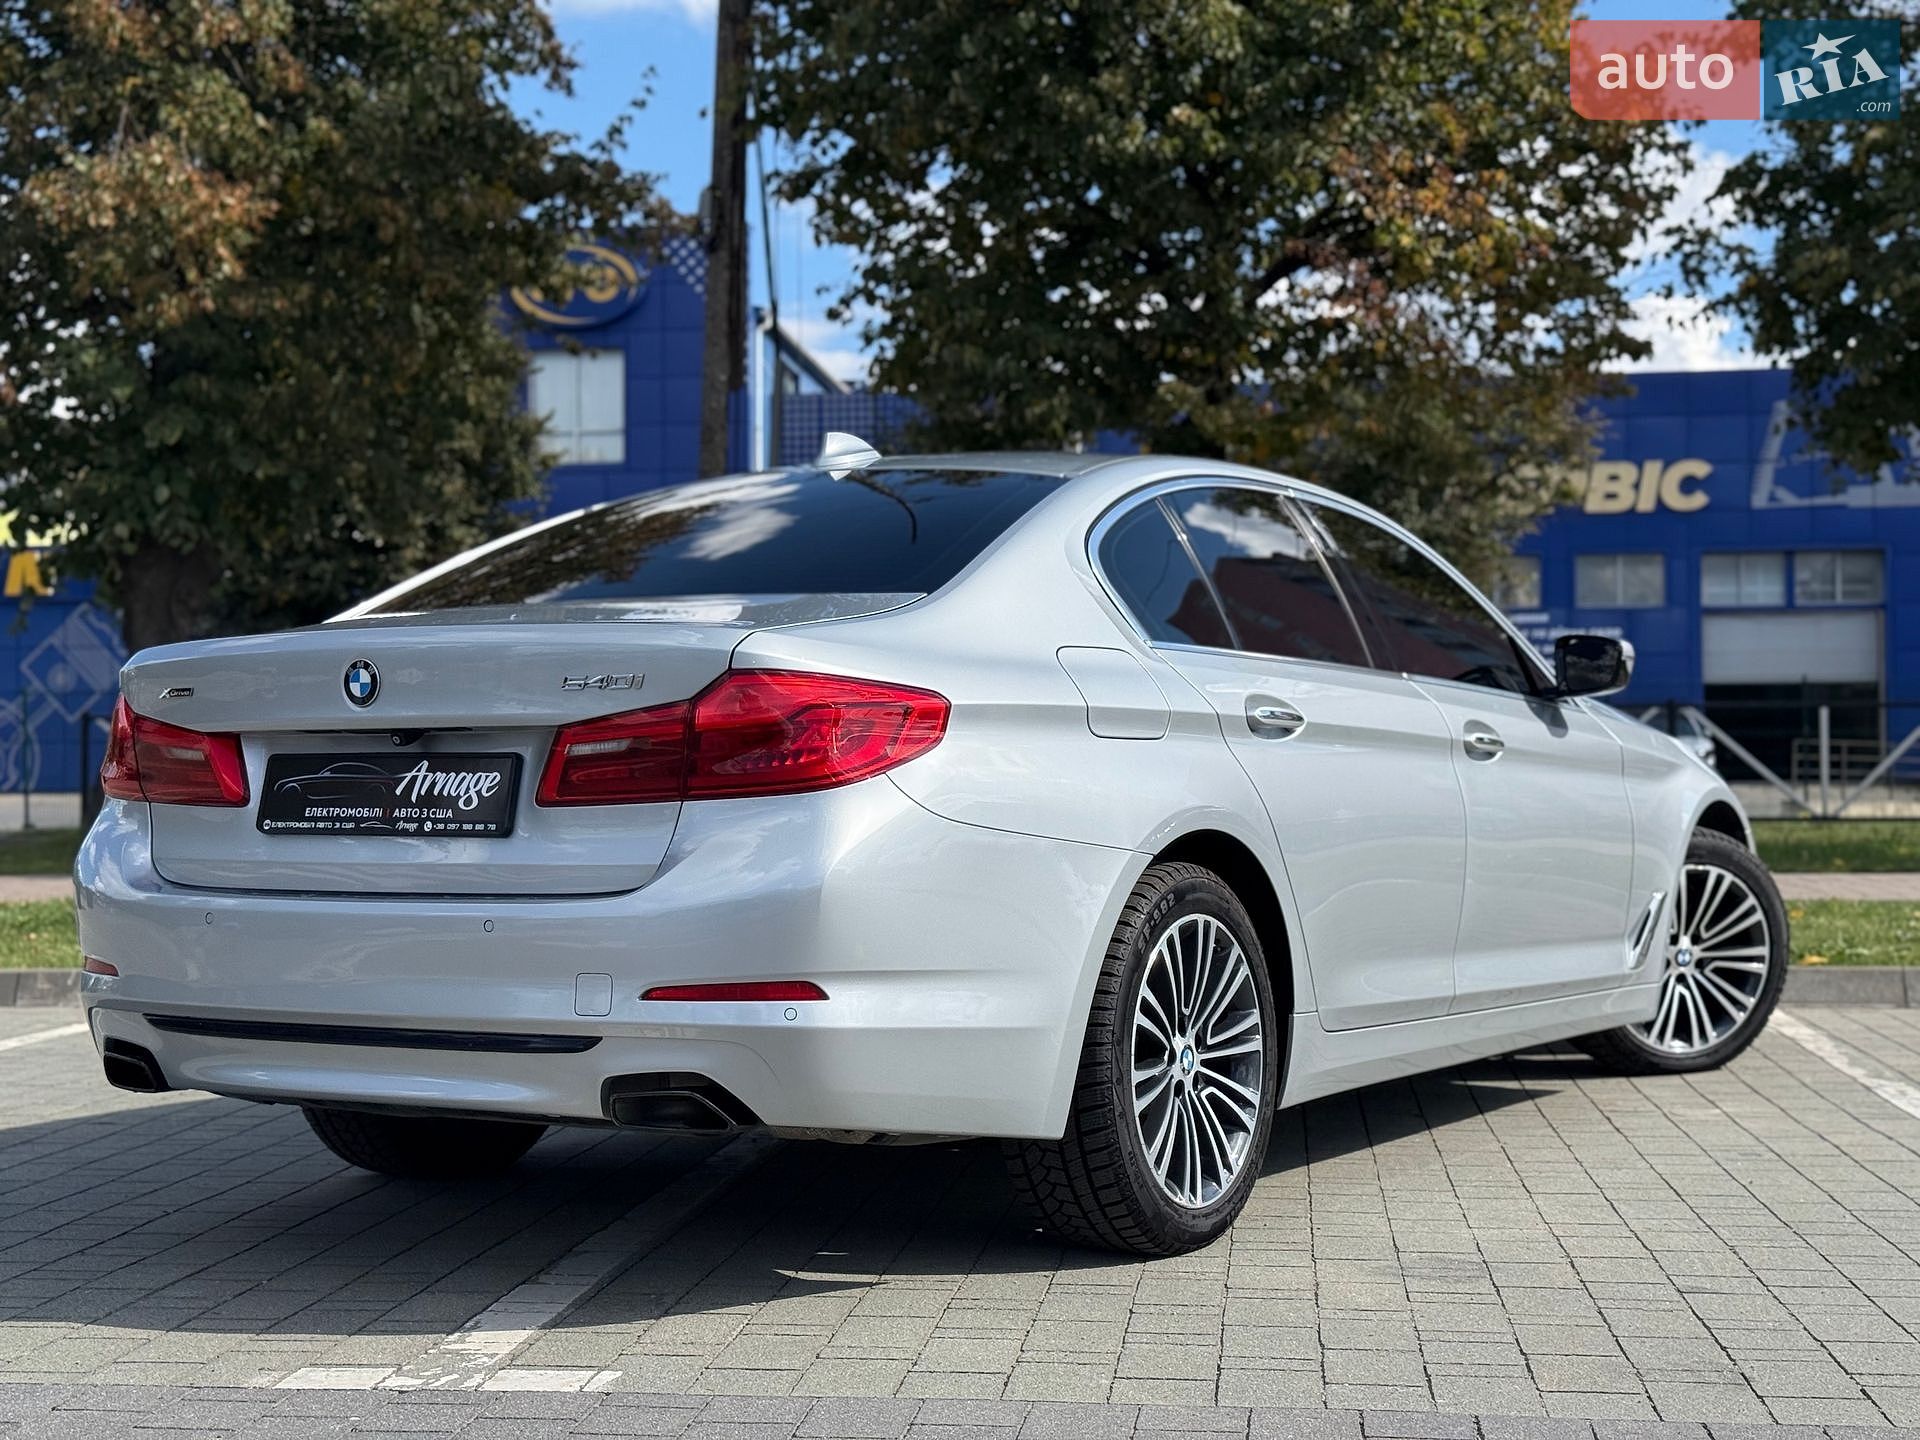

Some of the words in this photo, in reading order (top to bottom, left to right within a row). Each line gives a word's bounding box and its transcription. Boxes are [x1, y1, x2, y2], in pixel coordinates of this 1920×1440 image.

[561, 673, 645, 691] 540i
[395, 760, 501, 811] Arnage
[304, 807, 383, 818] ЕЛЕКТРОМОБІЛІ
[392, 808, 420, 818] АВТО
[429, 808, 453, 819] США
[395, 820, 419, 832] Arnage
